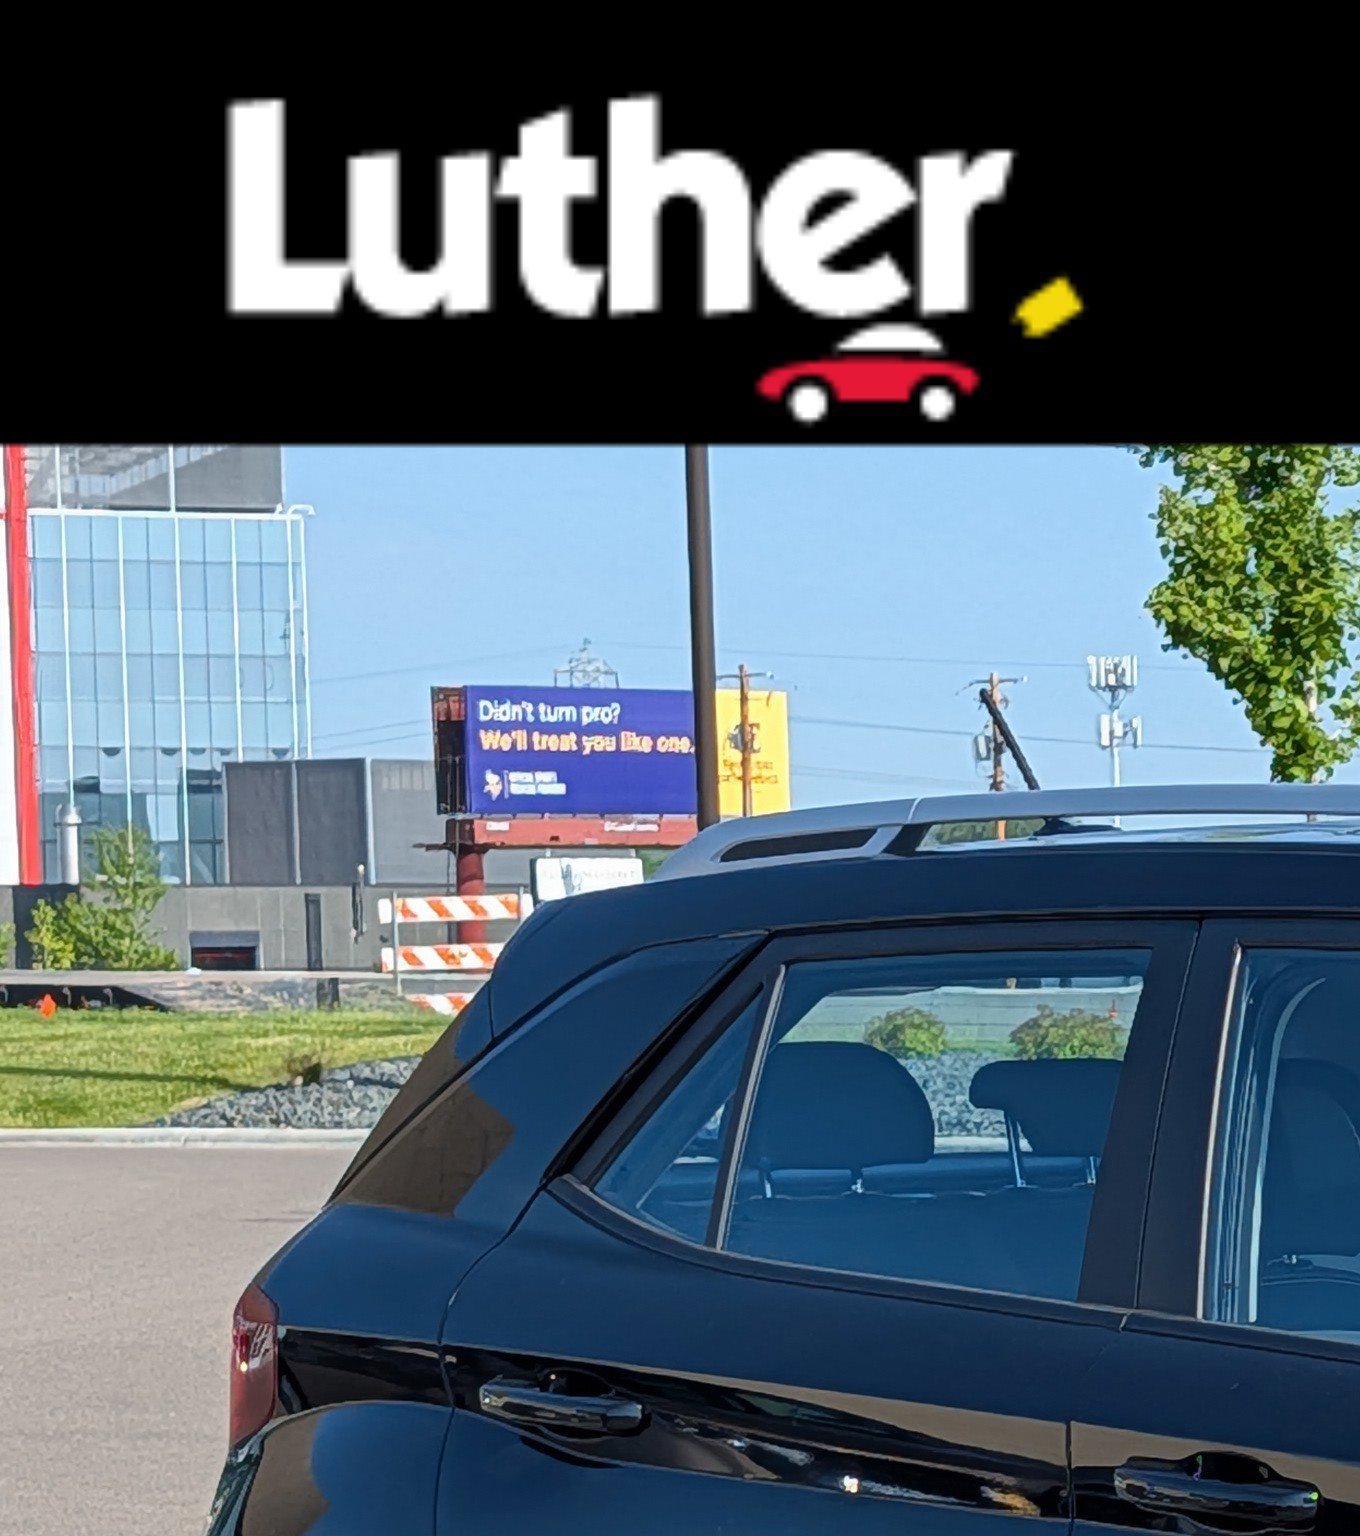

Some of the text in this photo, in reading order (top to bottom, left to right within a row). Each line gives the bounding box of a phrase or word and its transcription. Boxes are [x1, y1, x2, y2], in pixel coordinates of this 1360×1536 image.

[478, 699, 621, 726] Didn't turn pro?
[479, 730, 528, 752] We'll
[532, 731, 579, 752] treat
[582, 735, 616, 756] you
[620, 731, 654, 753] like
